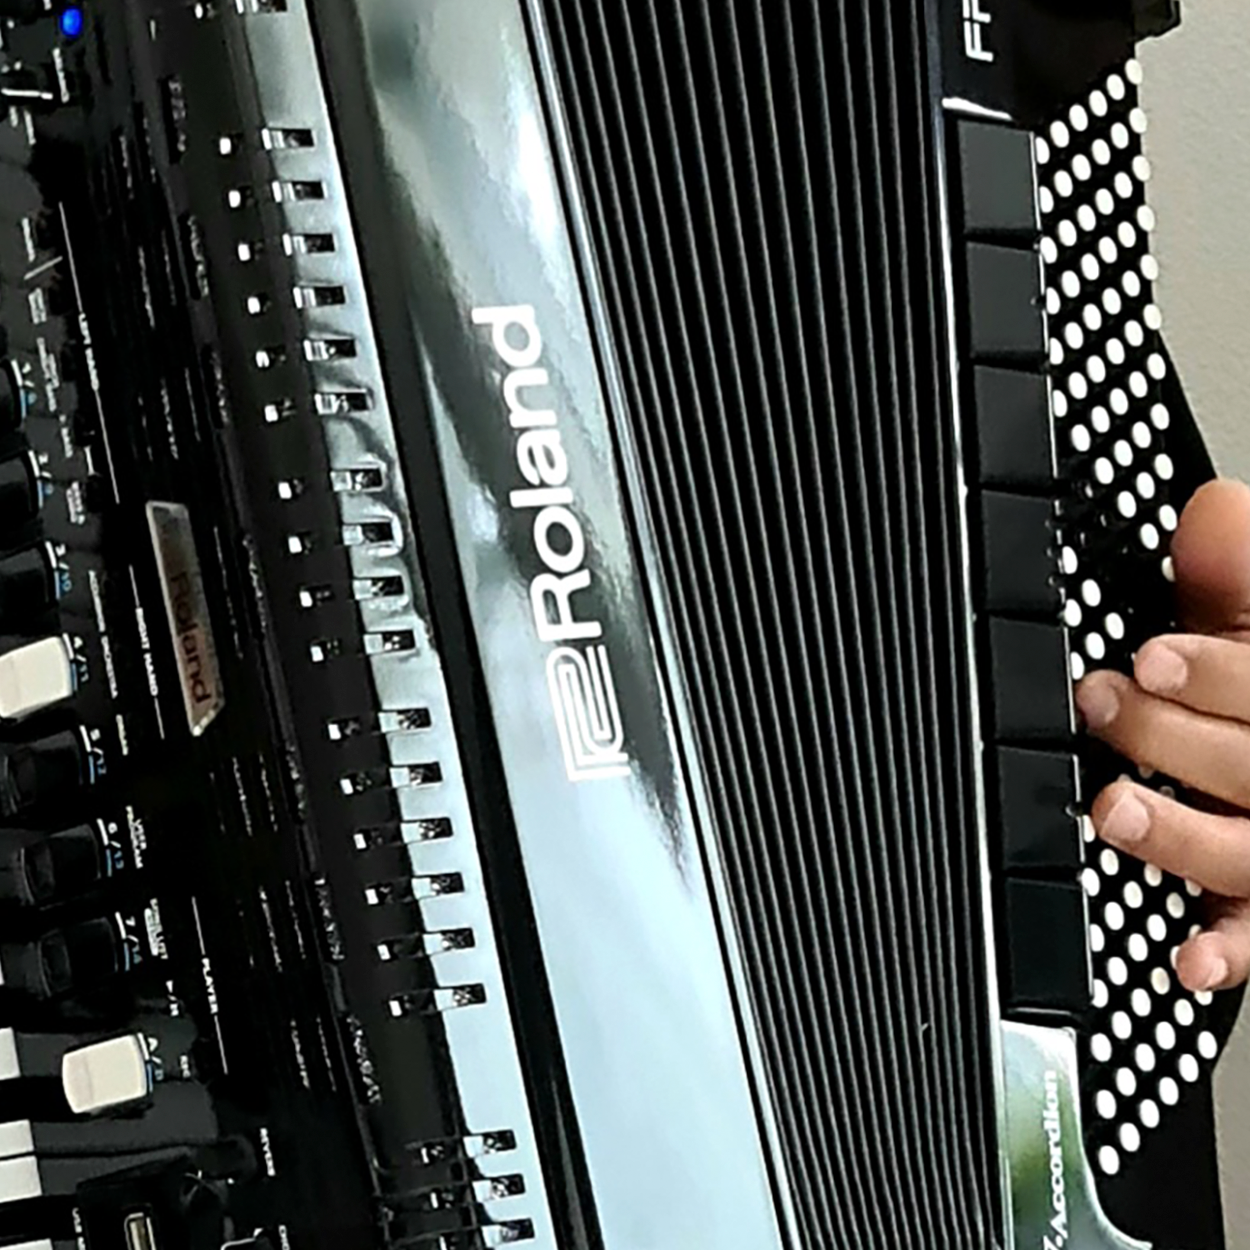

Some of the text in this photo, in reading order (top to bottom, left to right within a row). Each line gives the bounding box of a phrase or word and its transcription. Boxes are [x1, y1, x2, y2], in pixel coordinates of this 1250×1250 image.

[471, 304, 603, 643] Roland
[172, 571, 212, 704] Roland
[201, 957, 219, 1014] PLAYER
